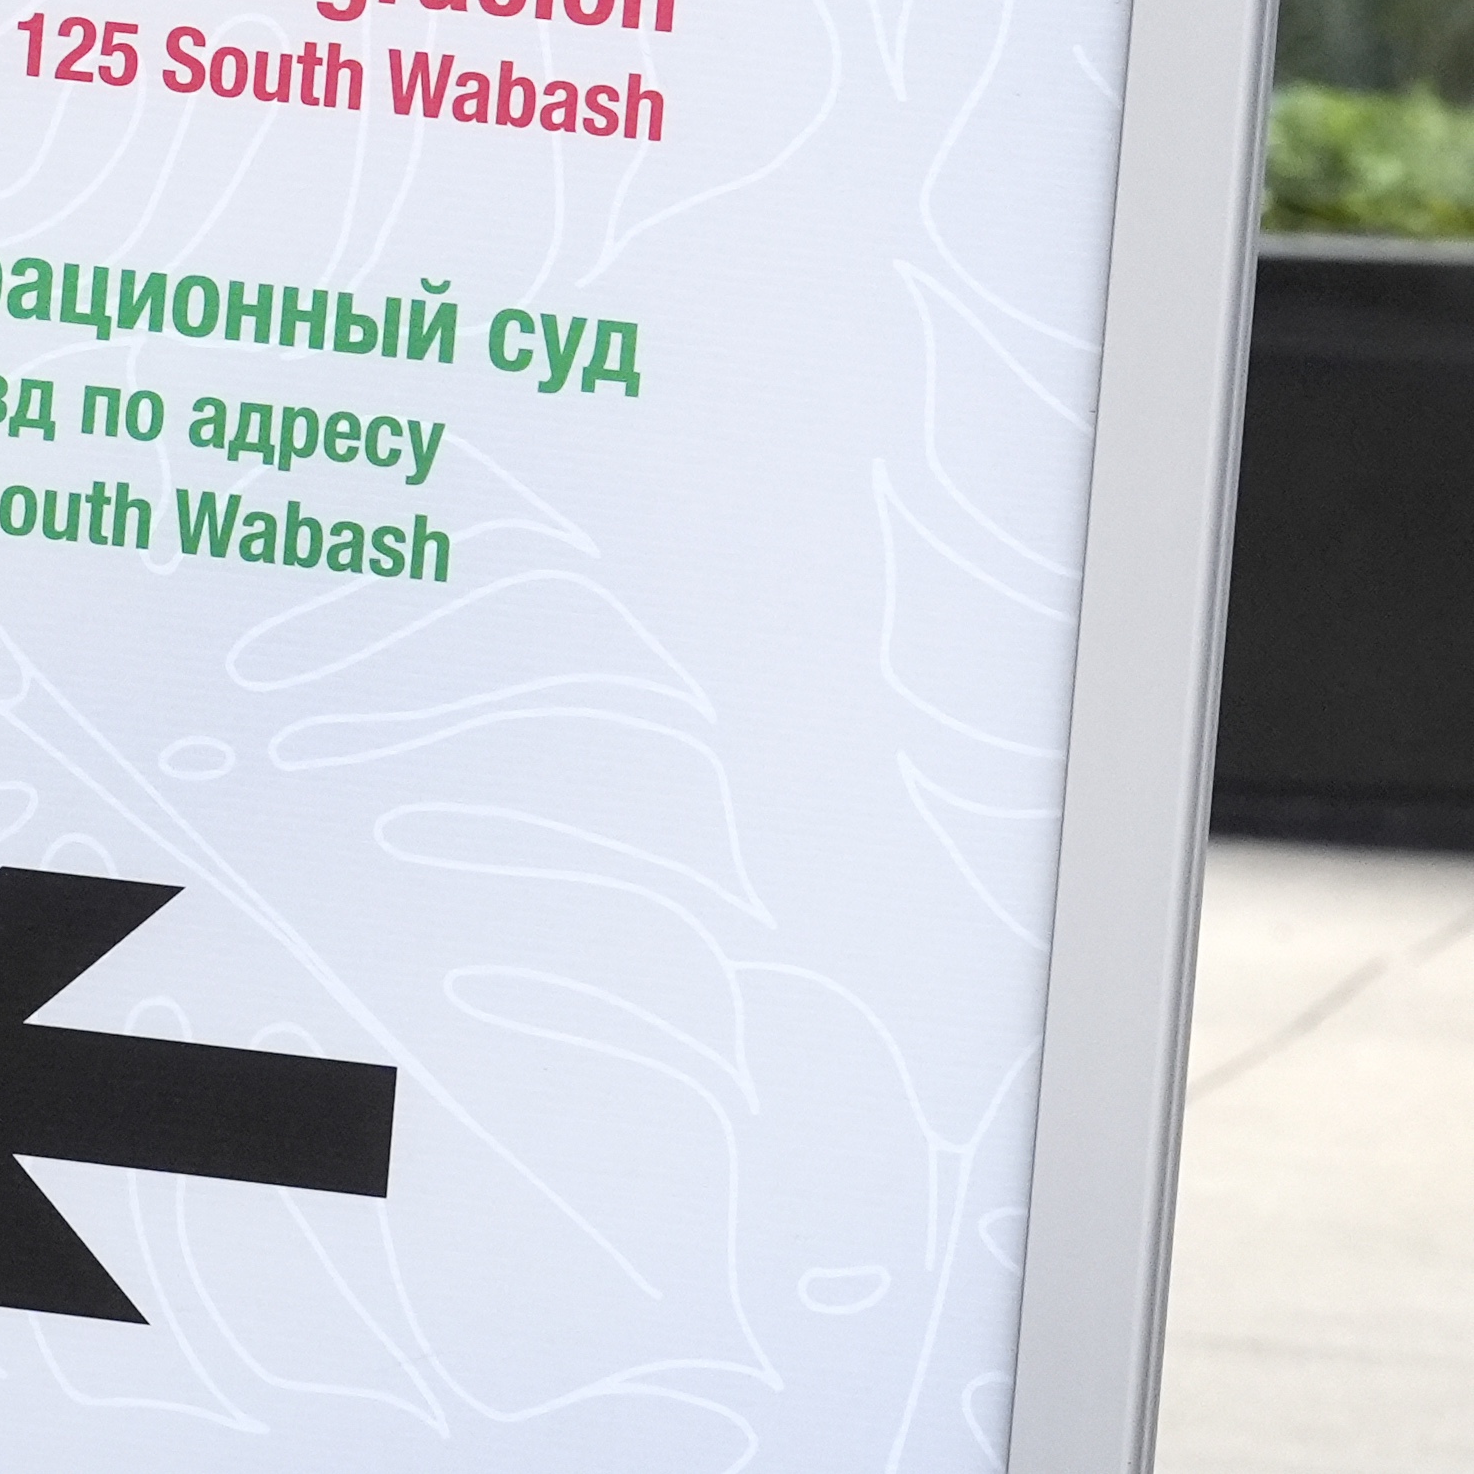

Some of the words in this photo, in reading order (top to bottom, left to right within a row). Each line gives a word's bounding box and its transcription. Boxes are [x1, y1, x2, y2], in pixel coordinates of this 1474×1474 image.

[17, 12, 139, 87] 125
[162, 25, 364, 111] South
[388, 48, 664, 142] Wabash
[488, 308, 641, 398] суд
[80, 384, 165, 442] по
[188, 396, 446, 486] адресу
[175, 488, 450, 583] Wabash
